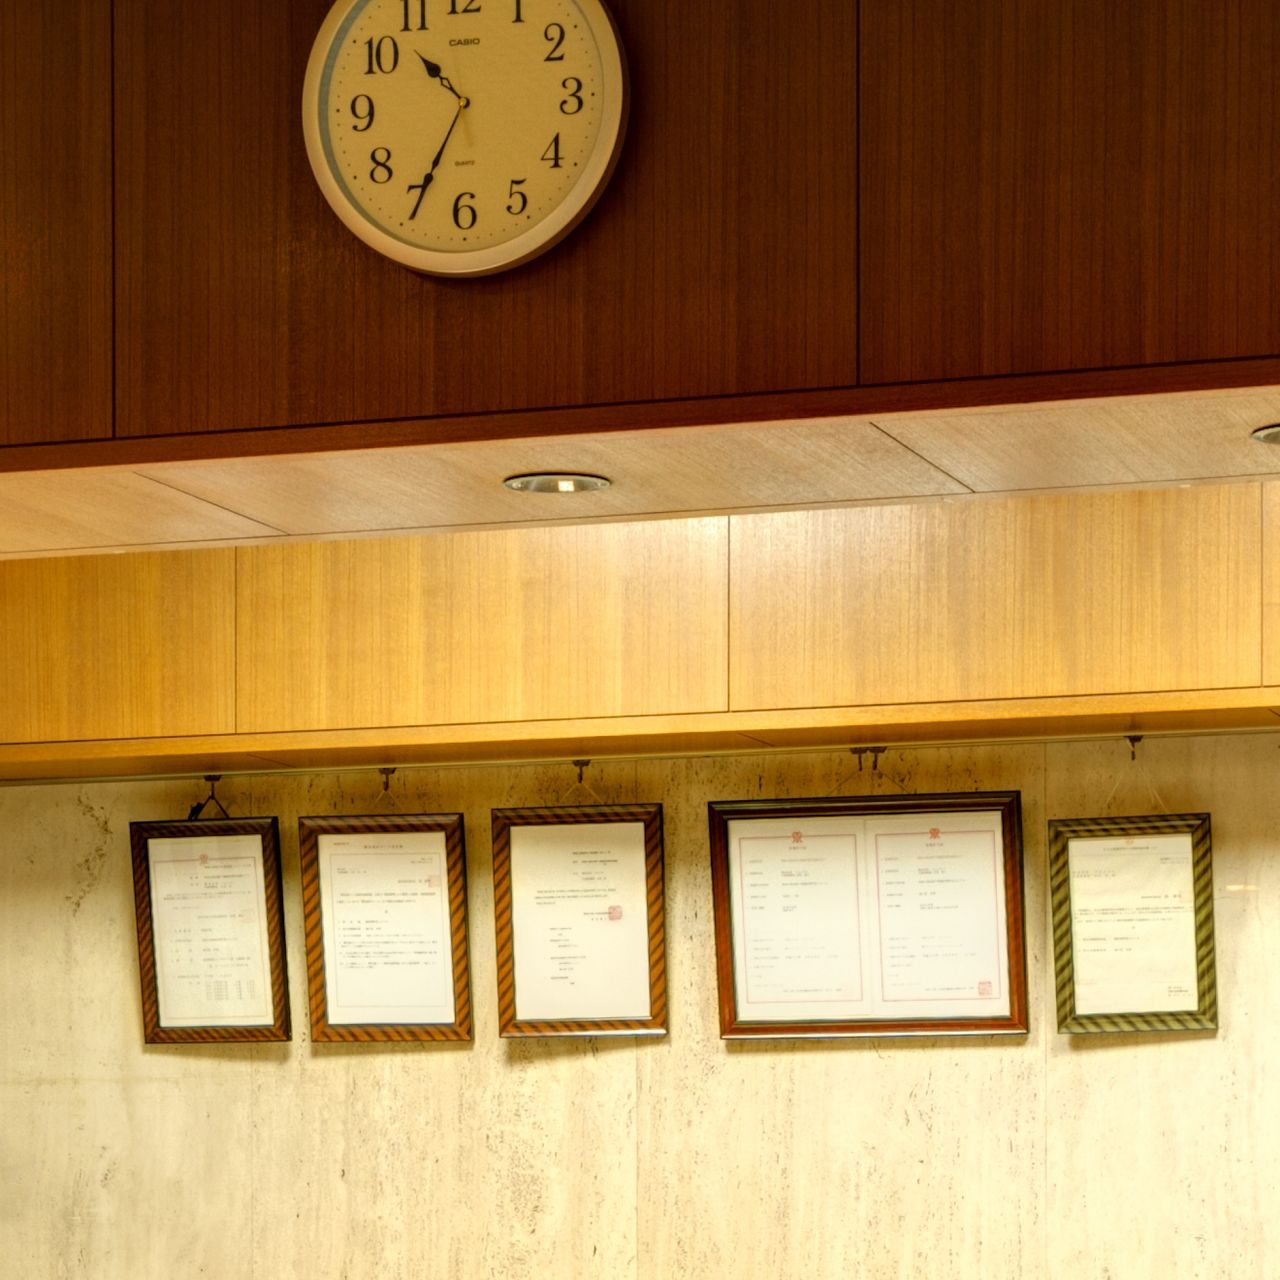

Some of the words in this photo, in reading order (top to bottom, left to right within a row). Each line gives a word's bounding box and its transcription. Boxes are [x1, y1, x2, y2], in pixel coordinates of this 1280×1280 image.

[400, 0, 429, 31] 11
[363, 35, 399, 75] 10
[449, 37, 480, 47] CASIO
[544, 23, 565, 61] 2
[350, 94, 375, 131] 9
[559, 77, 584, 115] 3
[370, 147, 393, 184] 8
[540, 132, 565, 168] 4
[407, 184, 431, 220] 7
[452, 192, 477, 230] 6
[506, 178, 528, 215] 5
